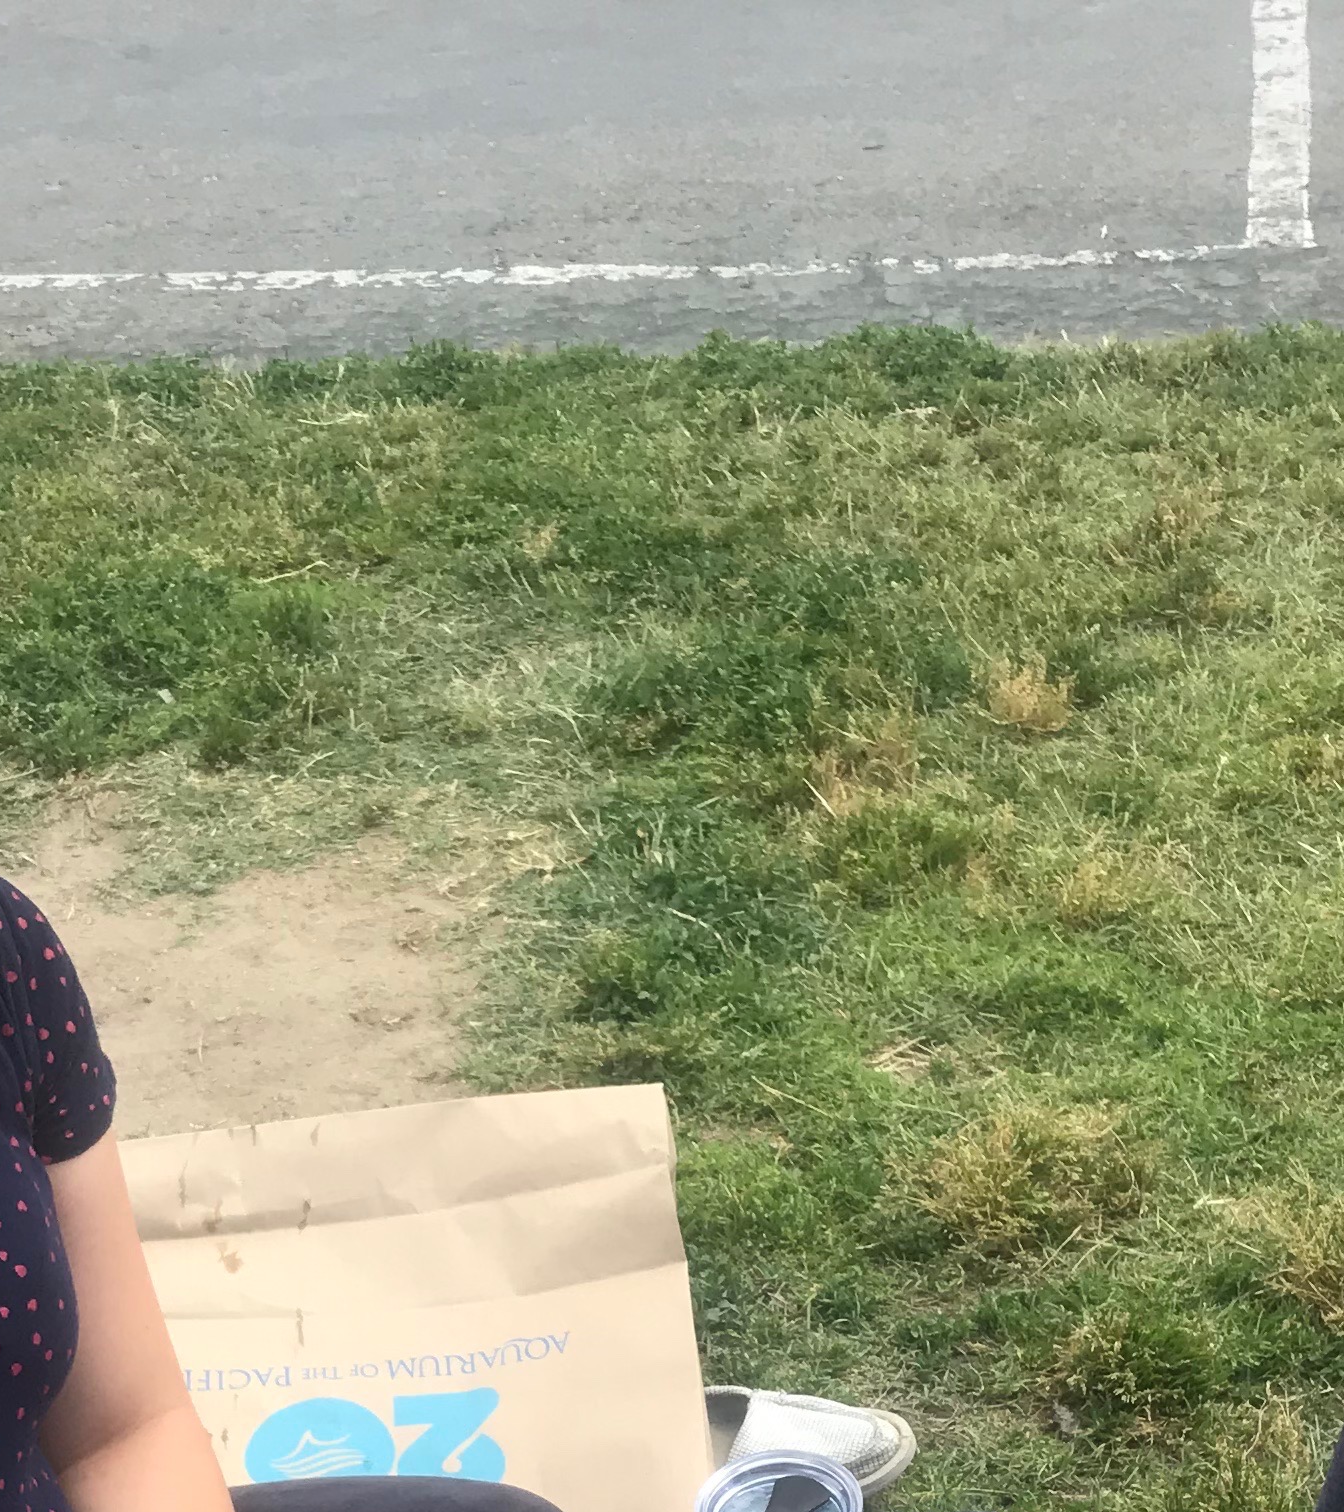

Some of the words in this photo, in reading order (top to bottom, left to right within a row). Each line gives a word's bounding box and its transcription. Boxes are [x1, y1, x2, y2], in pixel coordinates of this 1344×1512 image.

[386, 1331, 570, 1381] AQUARIUM
[185, 1366, 292, 1392] PACIFI
[302, 1365, 343, 1381] THE
[350, 1363, 379, 1379] OF
